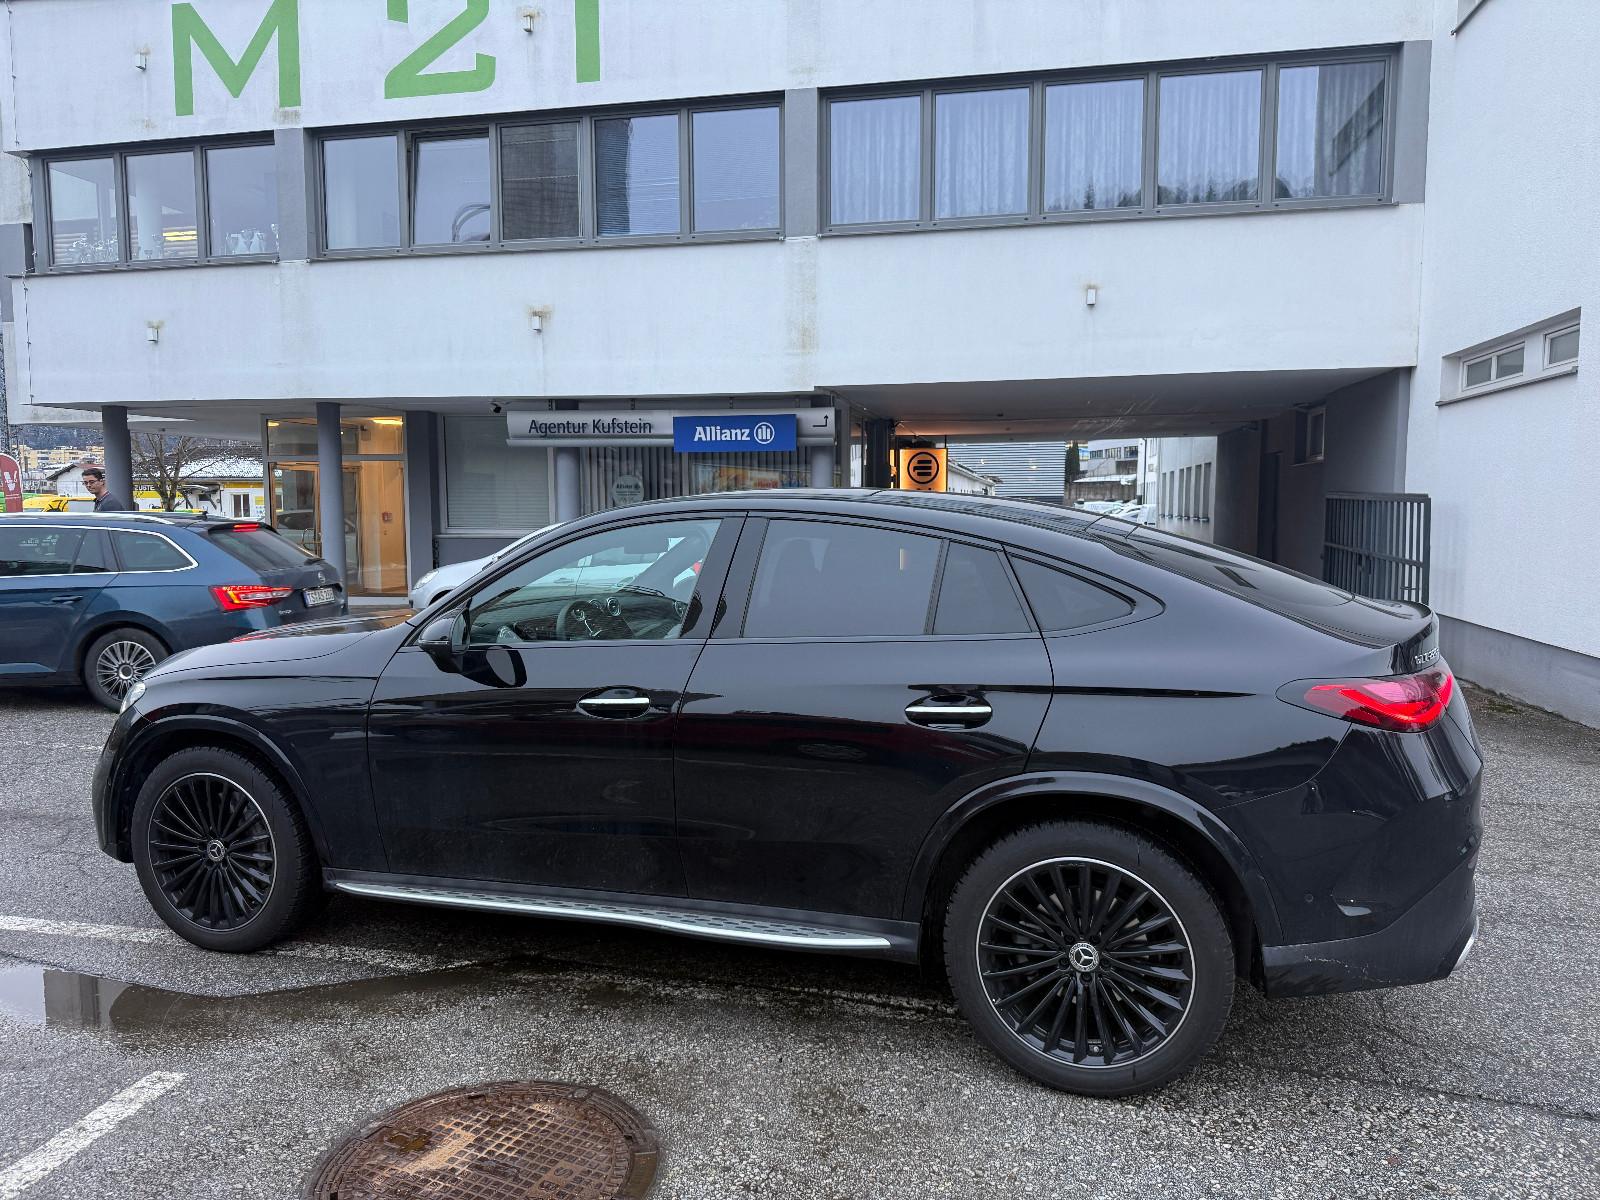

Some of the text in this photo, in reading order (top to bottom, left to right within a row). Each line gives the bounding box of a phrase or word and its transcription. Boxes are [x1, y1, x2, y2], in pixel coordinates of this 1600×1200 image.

[171, 0, 301, 117] M
[528, 417, 652, 438] Agentur Kufstein
[693, 425, 751, 442] Allianz
